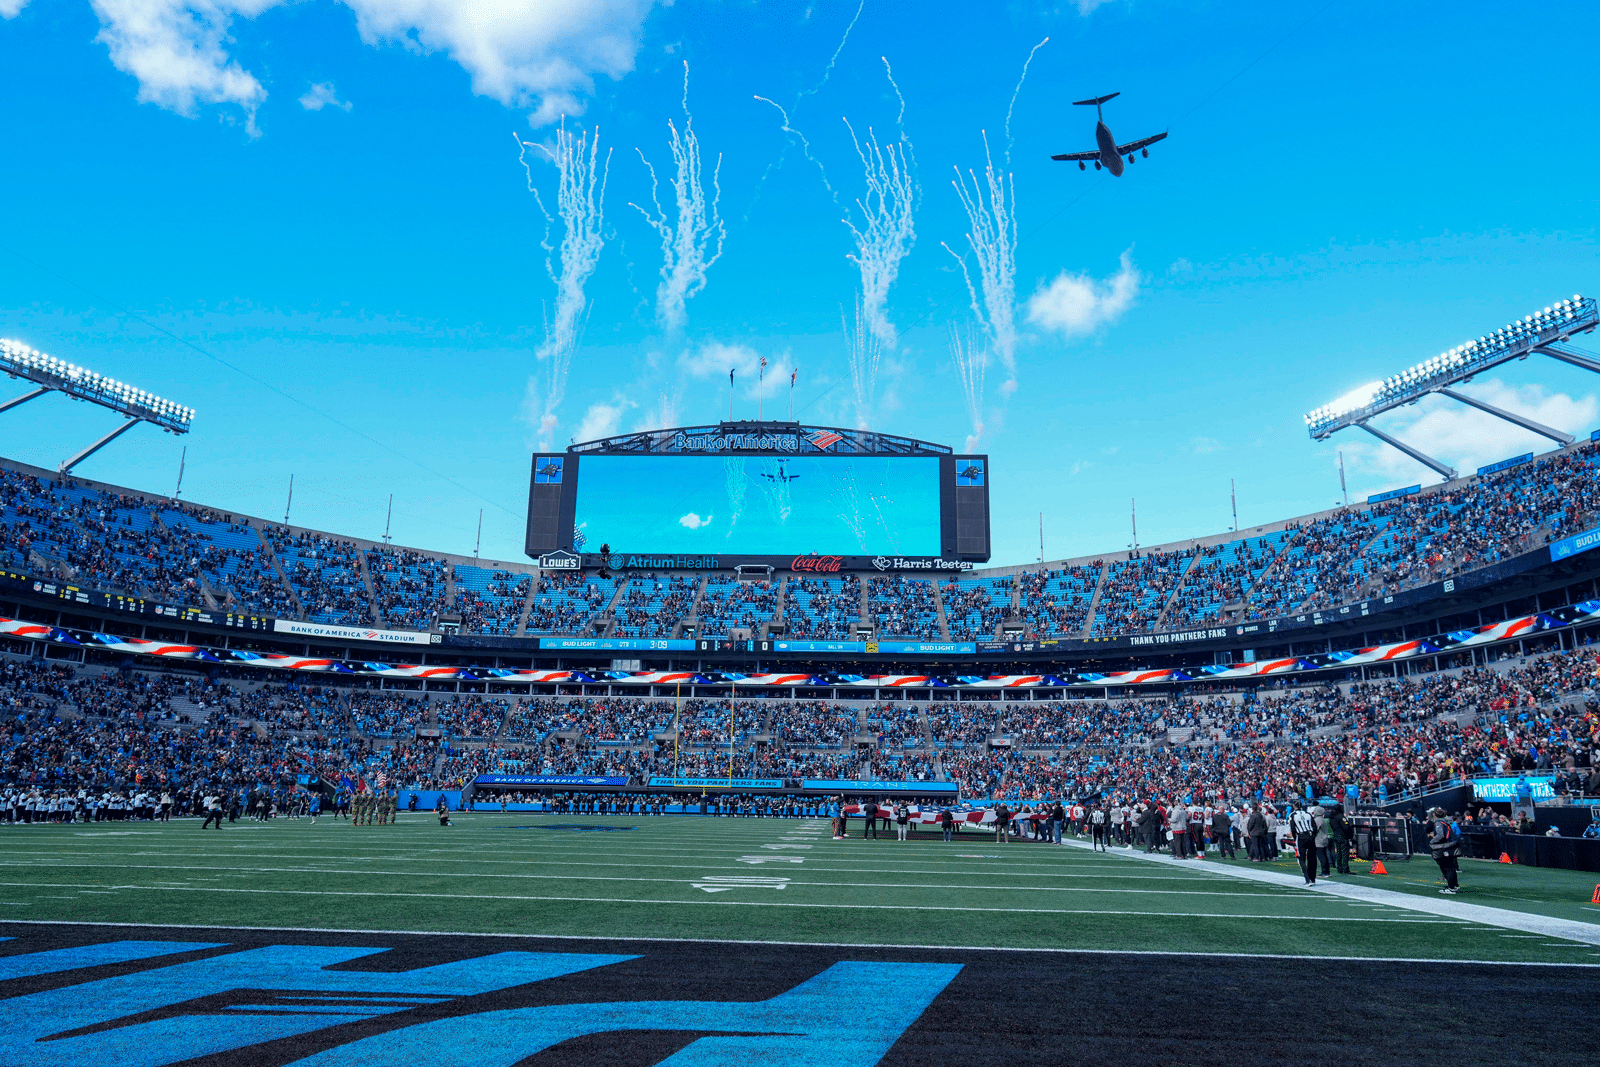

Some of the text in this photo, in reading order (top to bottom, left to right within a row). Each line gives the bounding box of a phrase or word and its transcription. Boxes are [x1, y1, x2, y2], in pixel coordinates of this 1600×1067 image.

[675, 434, 798, 449] Bank of America
[1576, 535, 1593, 548] BUD
[542, 557, 577, 568] LOWE'S
[627, 556, 719, 568] Atrium Health
[791, 555, 844, 572] Coca-Cola
[894, 558, 972, 568] Harris Teeter
[291, 626, 312, 634] BANK
[326, 630, 360, 638] AMERICA
[1130, 628, 1226, 646] THANK YOU PANTHERS FANS
[650, 640, 668, 649] 3:09
[701, 641, 708, 650] 0
[762, 642, 768, 651] 0
